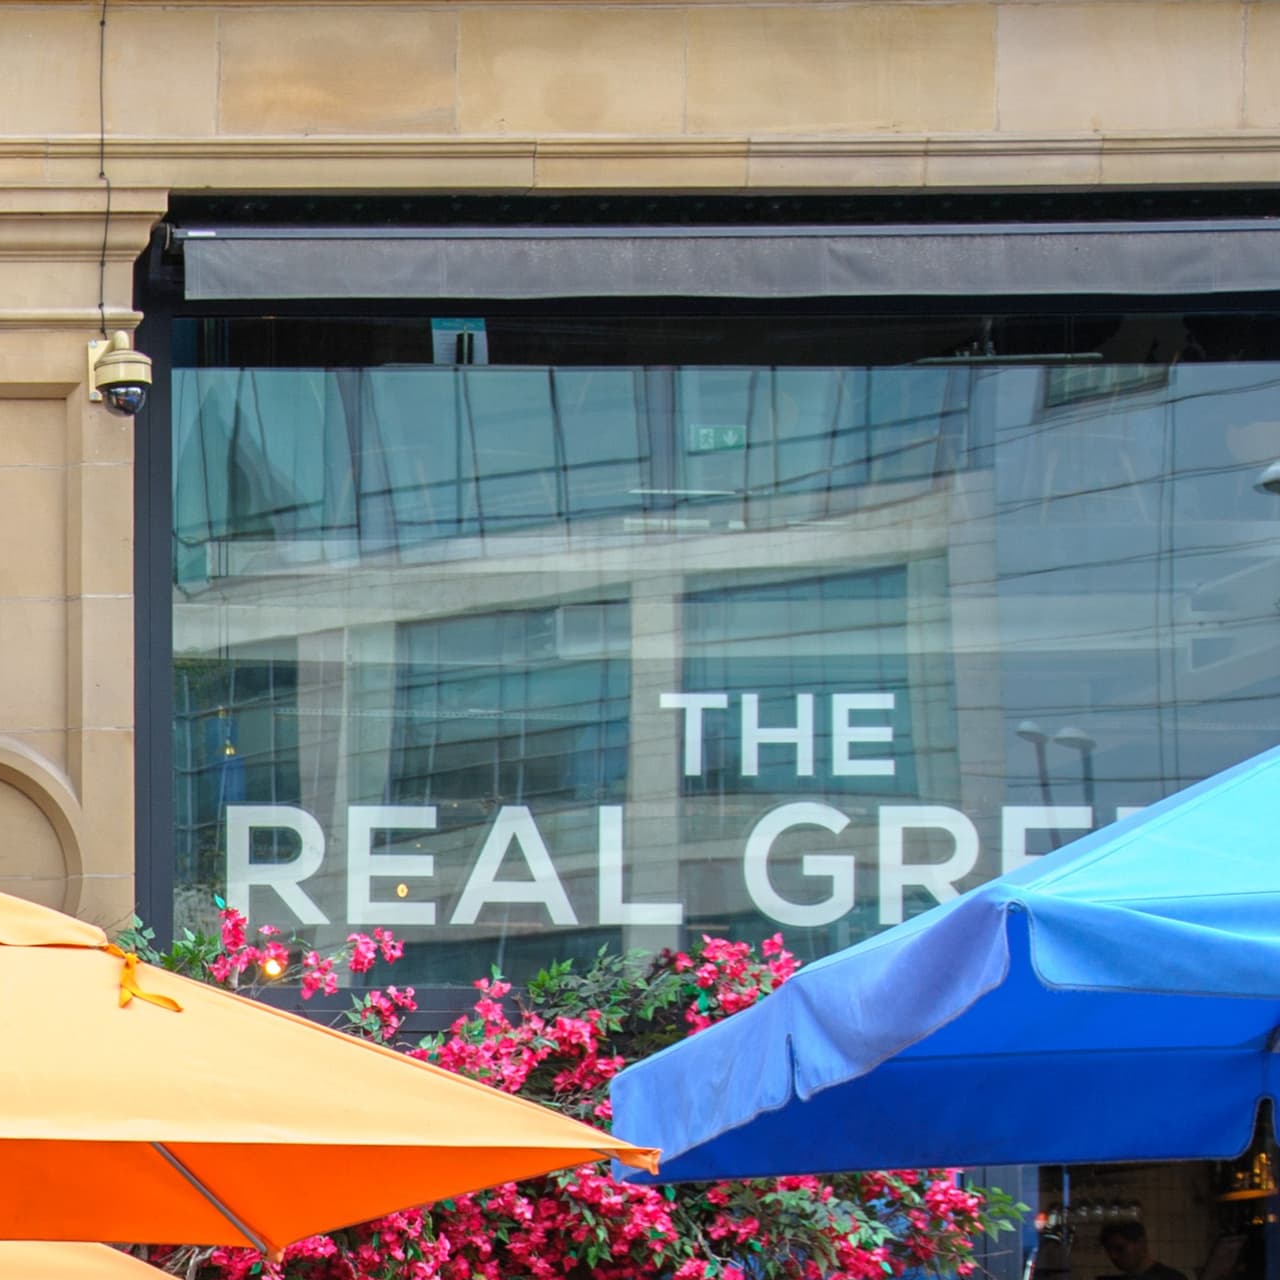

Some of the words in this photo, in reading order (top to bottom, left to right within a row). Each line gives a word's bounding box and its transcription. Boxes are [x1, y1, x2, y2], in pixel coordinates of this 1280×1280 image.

[658, 693, 895, 776] THE
[226, 805, 683, 927] REAL
[742, 802, 1149, 928] GRE
